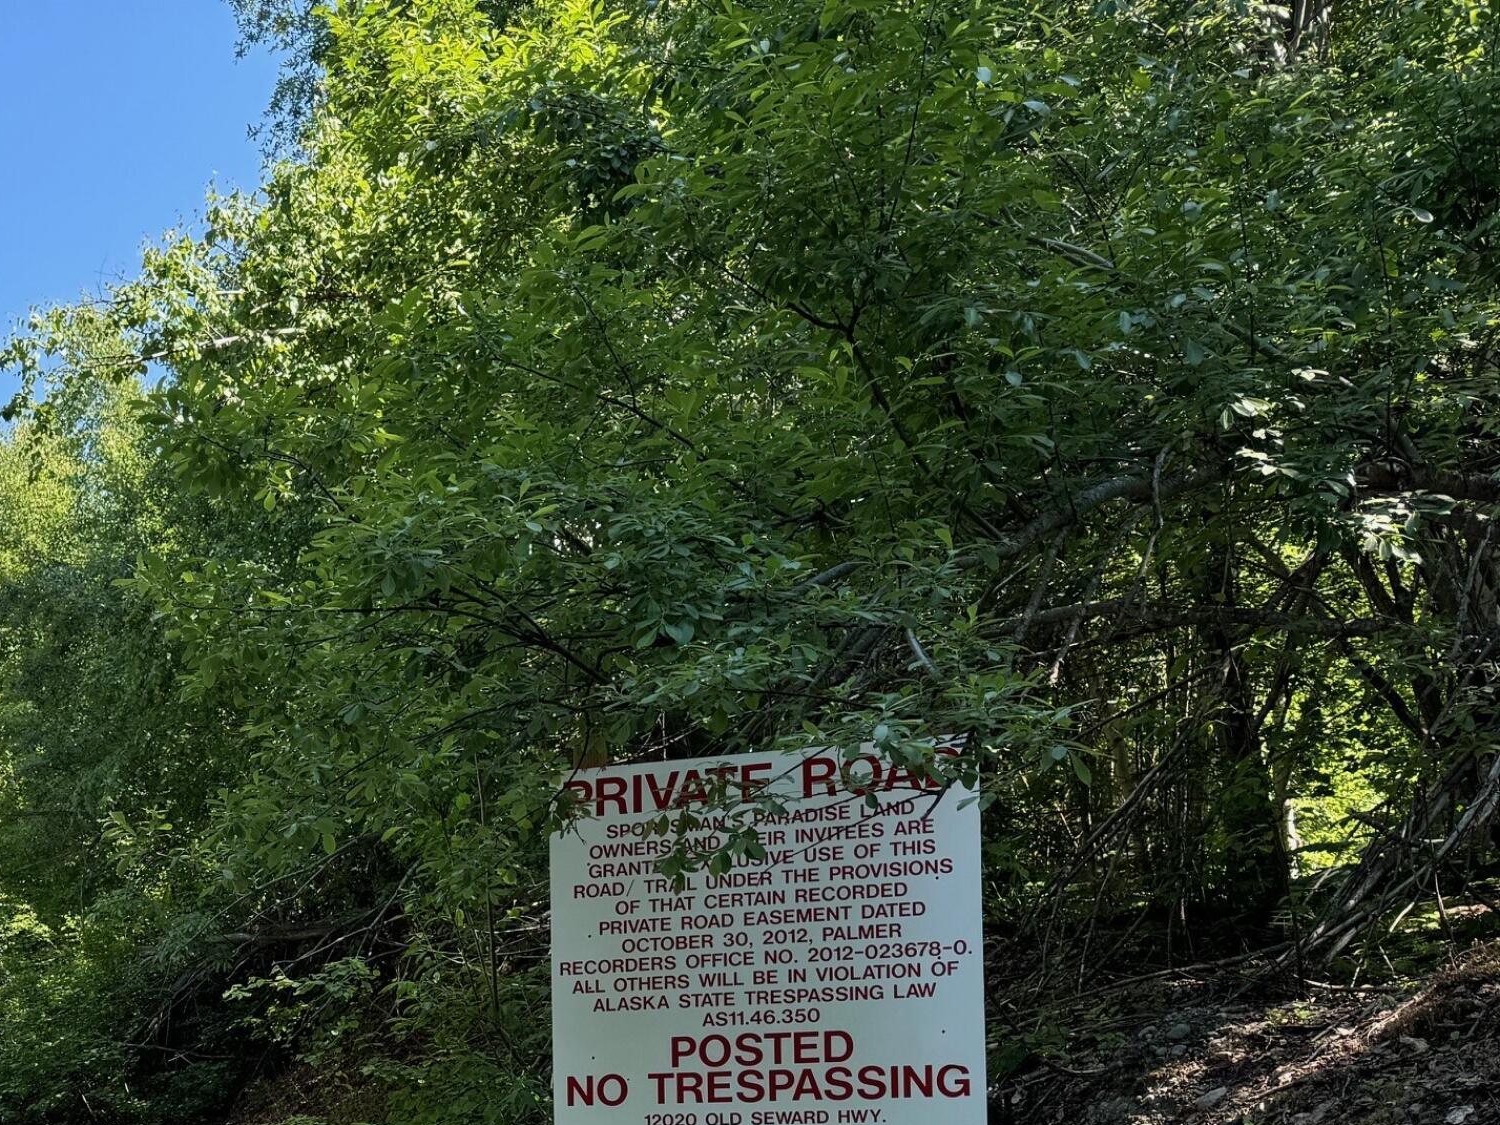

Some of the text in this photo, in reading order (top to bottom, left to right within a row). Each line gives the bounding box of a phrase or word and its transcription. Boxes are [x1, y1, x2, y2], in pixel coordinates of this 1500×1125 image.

[606, 800, 915, 839] SPOSAN'S PARADISE LAND
[590, 840, 672, 860] OWNERS
[796, 823, 884, 844] INVITEES
[894, 818, 934, 836] ARE
[589, 858, 678, 879] GRANT
[804, 846, 844, 863] USE
[853, 844, 881, 859] OF
[889, 839, 936, 856] THIS
[706, 871, 772, 890] UNDER
[781, 868, 820, 884] THE
[829, 858, 954, 881] PROVISIONS
[615, 882, 908, 915] OF THAT CERTAIN RECORDED
[599, 901, 926, 935] PRIVATE ROAD EASEMENT DATED
[622, 923, 902, 953] OCTOBER 30, 2012, PALMER
[559, 939, 973, 976] RECORDERS OFFICE NO. 2012-023678-0.
[572, 961, 959, 995] ALL OTHERS WILL BE IN VIOLATION OF
[593, 982, 937, 1012] ALASKA STATE TRESPASSING LAW
[702, 1007, 820, 1027] AS11.46.350
[671, 1030, 854, 1068] POSTED
[566, 1064, 971, 1107] NO TRESPASSING
[750, 1110, 829, 1125] SEWARD
[838, 1109, 886, 1124] HWY.
